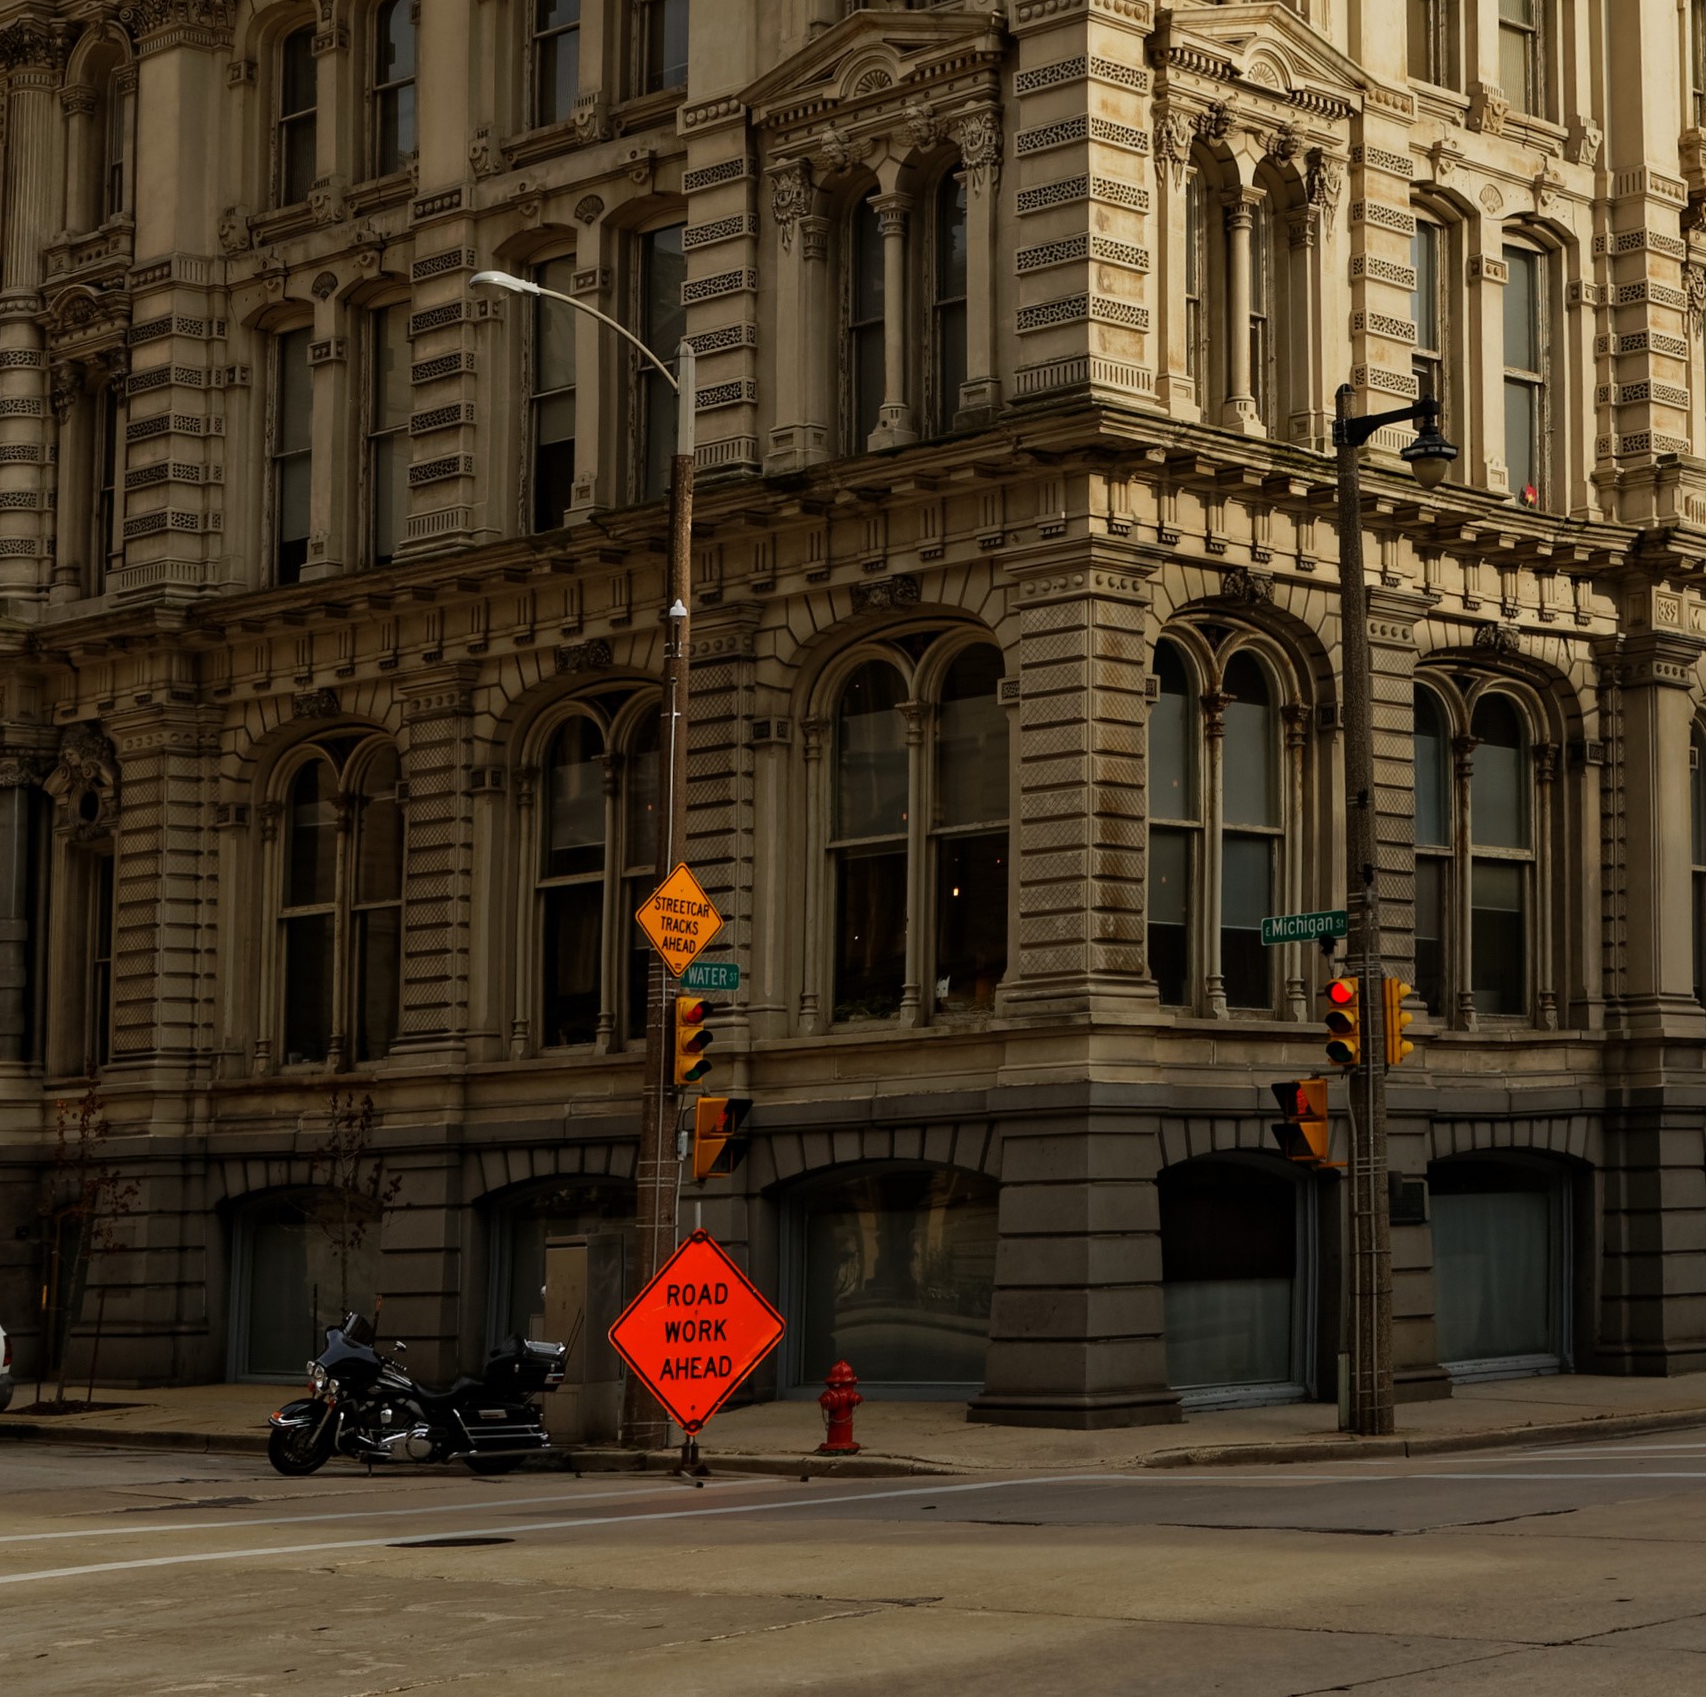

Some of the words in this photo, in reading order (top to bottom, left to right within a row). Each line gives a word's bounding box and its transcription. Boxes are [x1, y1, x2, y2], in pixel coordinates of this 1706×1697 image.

[655, 896, 710, 918] STREETCAR
[661, 916, 699, 936] TRACKS
[1265, 927, 1271, 937] E
[1272, 915, 1333, 938] Michigan
[1336, 919, 1344, 929] St
[662, 936, 696, 954] AHEAD
[689, 966, 727, 986] WATER
[729, 972, 738, 983] ST
[667, 1283, 728, 1306] ROAD
[665, 1319, 727, 1343] WORK
[659, 1356, 732, 1381] AHEAD
